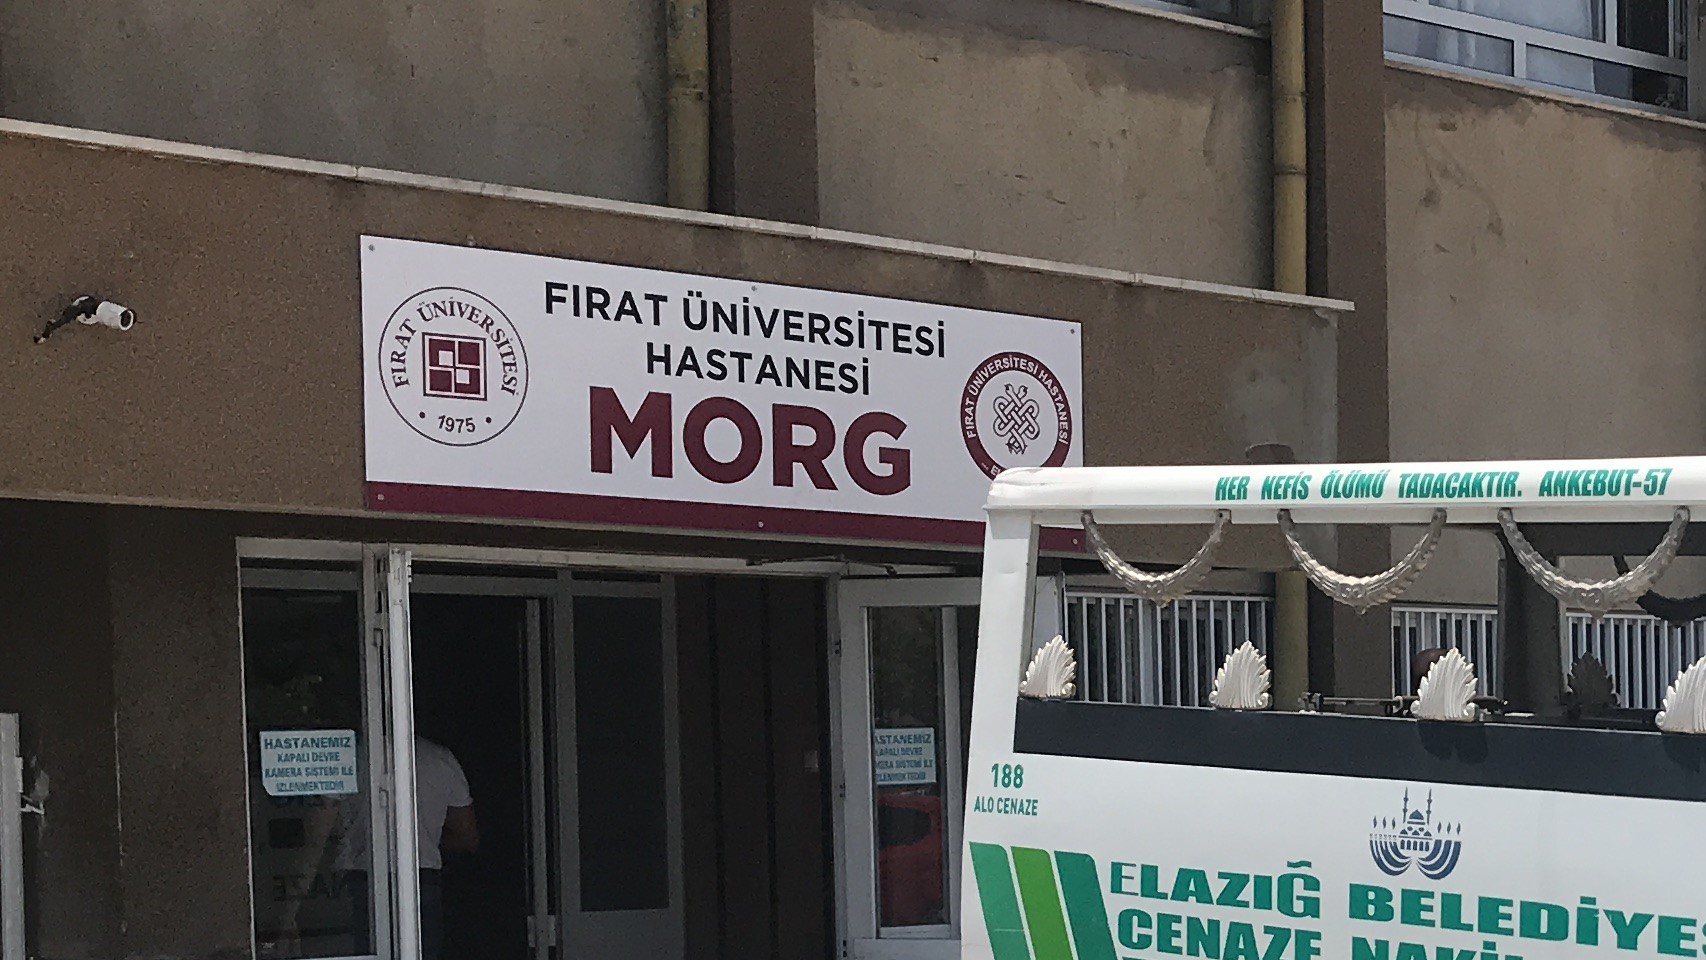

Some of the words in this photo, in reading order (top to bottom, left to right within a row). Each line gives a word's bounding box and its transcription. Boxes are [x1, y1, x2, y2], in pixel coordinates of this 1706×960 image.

[544, 281, 669, 326] FIRAT
[682, 290, 946, 358] ÜNİVERSİTESİ
[390, 318, 417, 389] FIRAT
[416, 296, 520, 396] ÜNİVERSİTESİ
[646, 341, 870, 396] HASTANESİ
[437, 414, 476, 434] 1975
[588, 385, 912, 496] MORG
[964, 397, 977, 439] FIRAT
[1215, 475, 1250, 501] HER
[1260, 471, 1313, 500] NEFİS
[1320, 468, 1391, 499] ÖLÜMÜ
[1397, 471, 1523, 499] TADACAKTIR.
[1538, 468, 1674, 498] ANKEBUT-57
[991, 763, 1024, 789] 188
[974, 795, 995, 813] ALO
[996, 797, 1039, 817] CENAZE
[1110, 860, 1321, 919] ELAZIĞ
